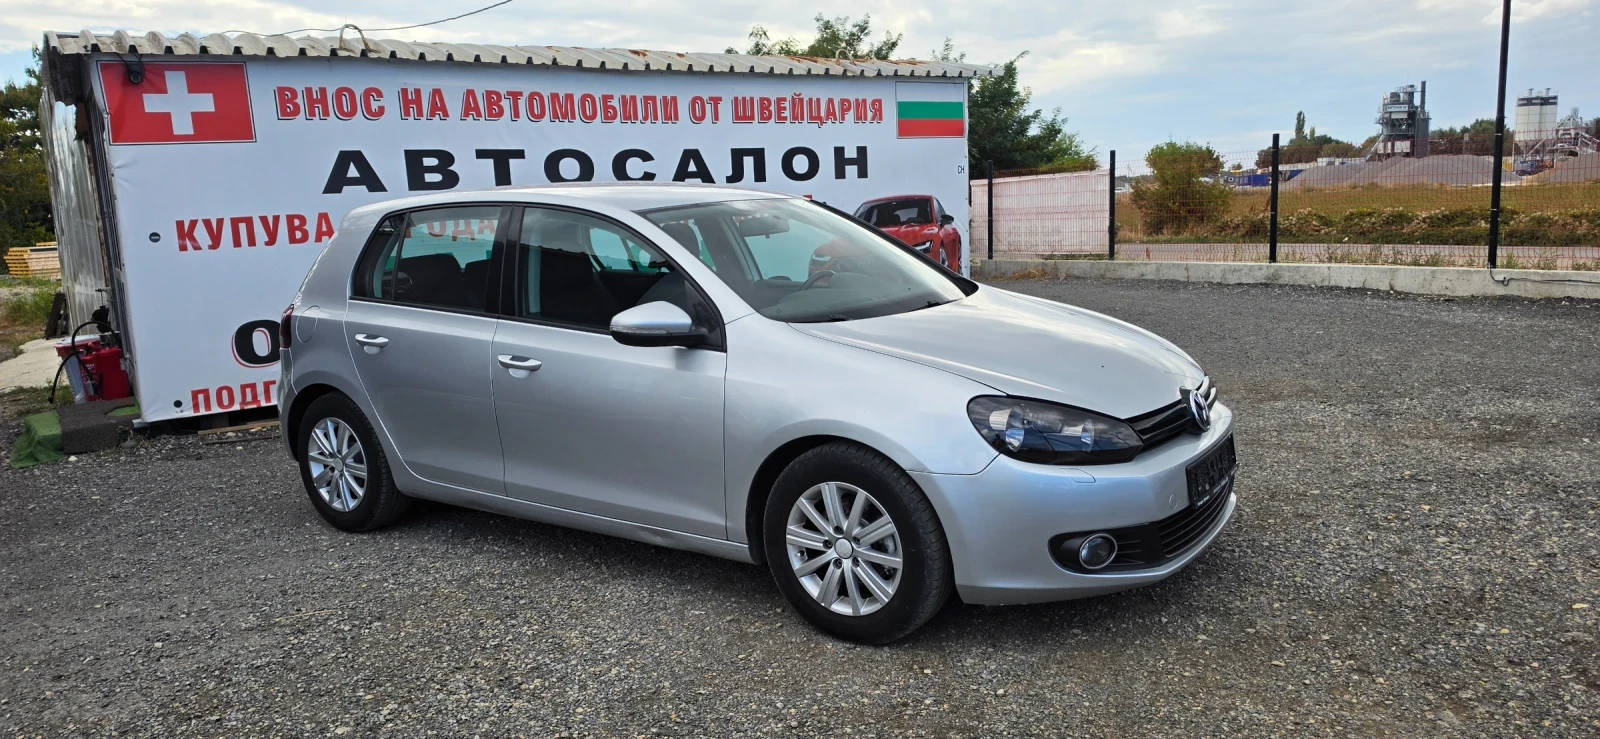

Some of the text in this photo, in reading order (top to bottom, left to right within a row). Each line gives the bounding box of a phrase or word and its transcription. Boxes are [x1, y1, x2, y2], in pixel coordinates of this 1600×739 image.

[275, 86, 883, 127] ВНОС НА АВТОМОБИЛИ ОТ ШВЕЙЦАРИЯ
[322, 146, 868, 195] АВТОСАЛОН
[191, 380, 277, 413] ПОДГ
